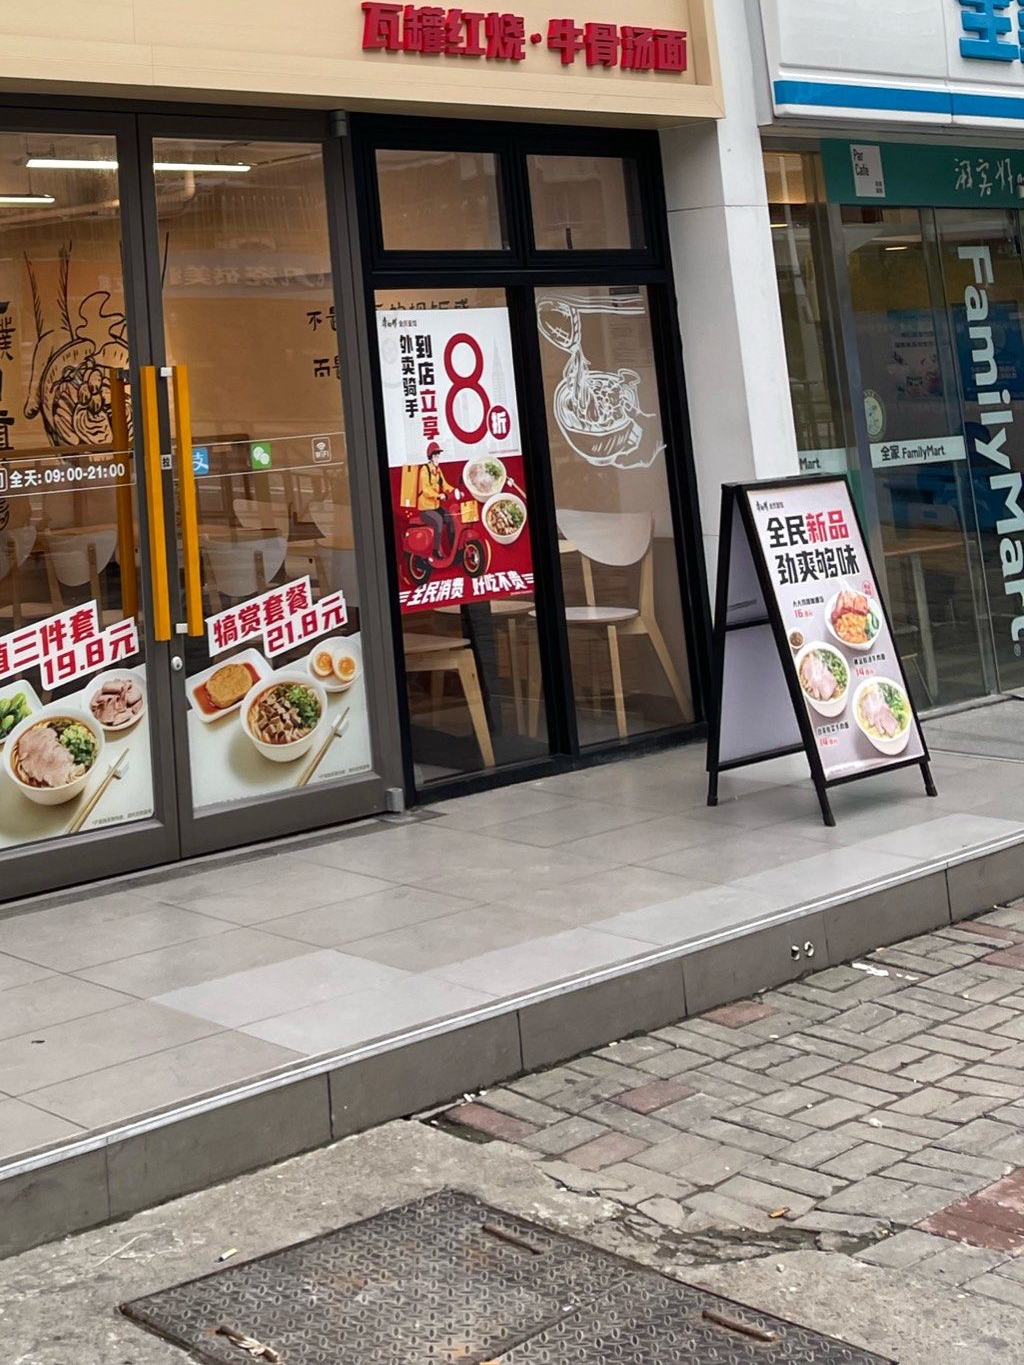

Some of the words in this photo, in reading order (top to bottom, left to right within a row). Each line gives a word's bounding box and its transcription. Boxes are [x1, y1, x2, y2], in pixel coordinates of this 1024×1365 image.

[400, 335, 418, 418] 外卖骑手
[416, 335, 439, 440] 到店立享
[880, 445, 900, 461] 全家
[902, 443, 946, 461] FamilyMart
[766, 510, 850, 549] 全民新品
[775, 544, 860, 586] 劲爽够味
[213, 582, 309, 648] 犒赏套餐
[268, 596, 345, 653] 21.8元
[44, 623, 136, 685] 19.8元
